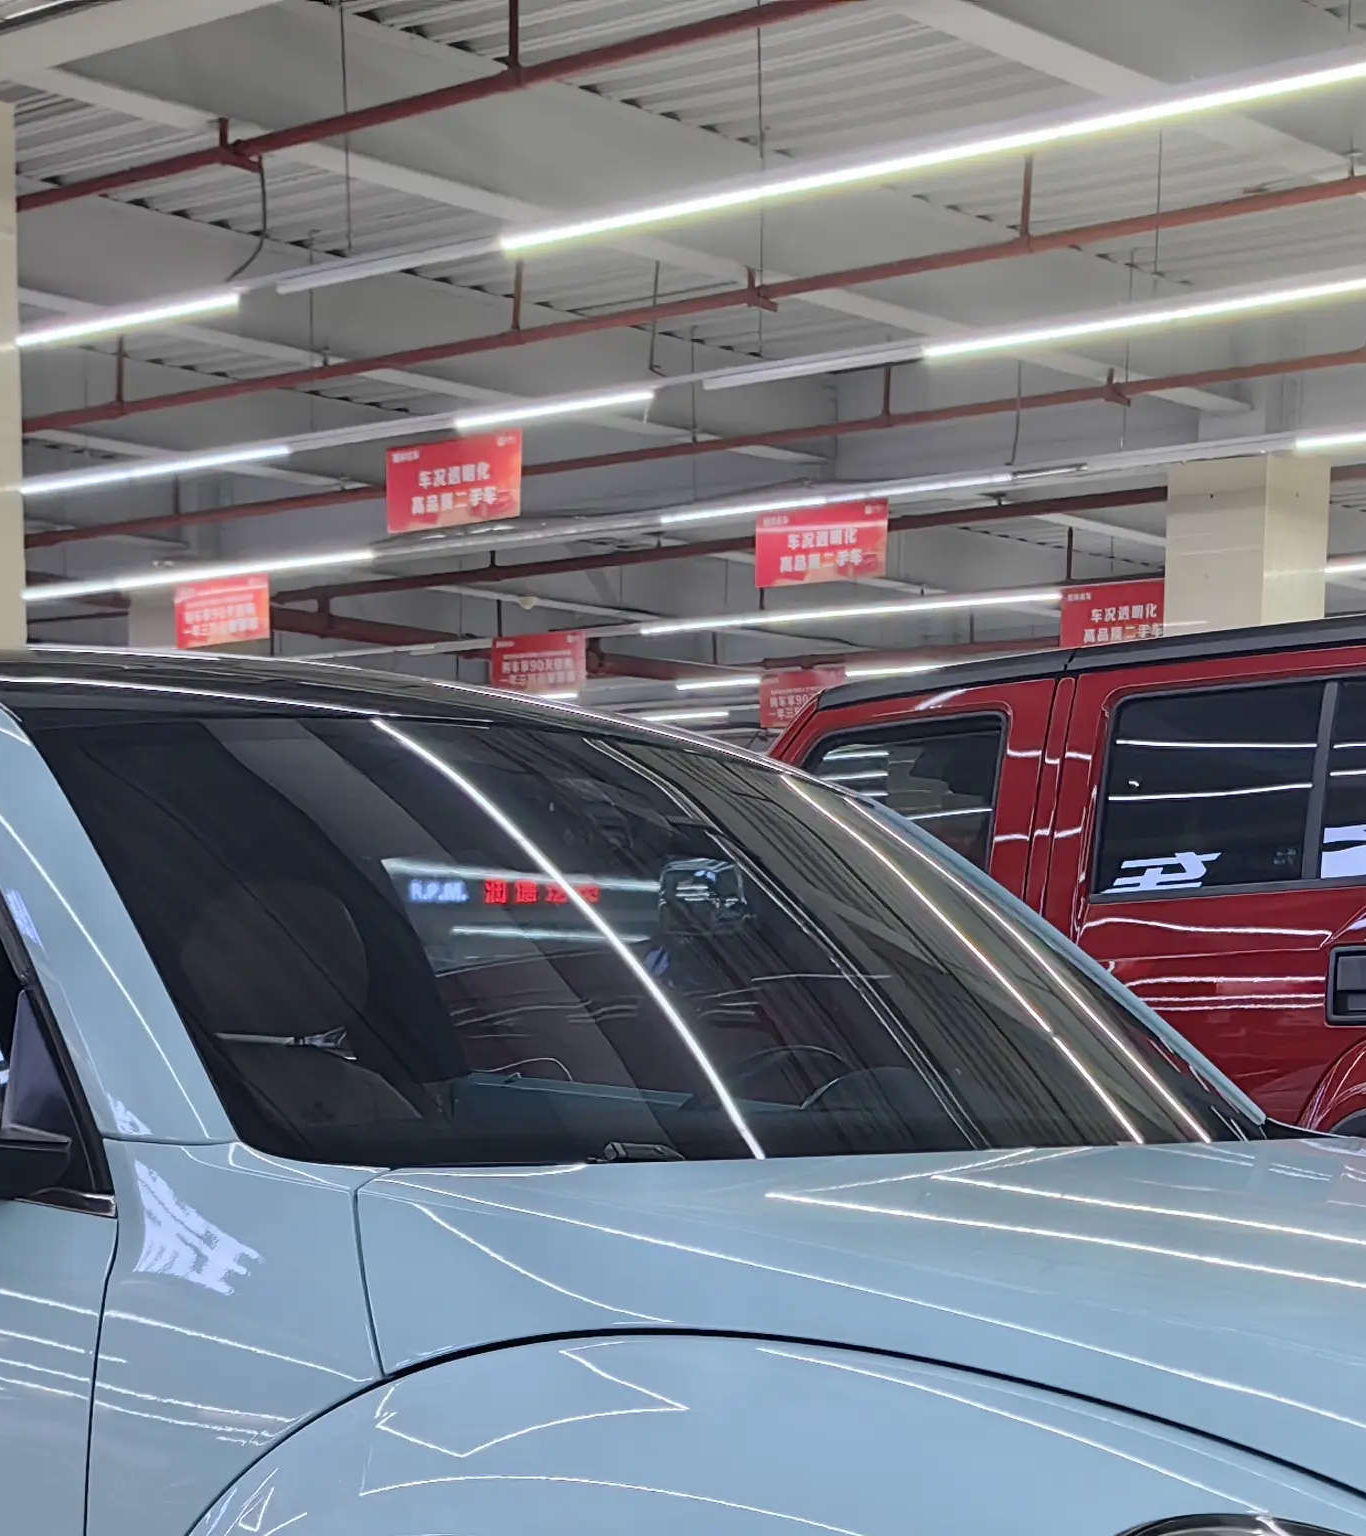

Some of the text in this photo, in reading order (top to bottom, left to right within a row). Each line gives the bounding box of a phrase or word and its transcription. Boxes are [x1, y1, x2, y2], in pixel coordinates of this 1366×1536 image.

[419, 462, 490, 489] 车况透明化
[411, 486, 498, 515] 高品质二手车
[787, 528, 857, 550] 车况透明化
[780, 548, 863, 573] 高品质二手车
[1091, 603, 1157, 623] 车况透明化
